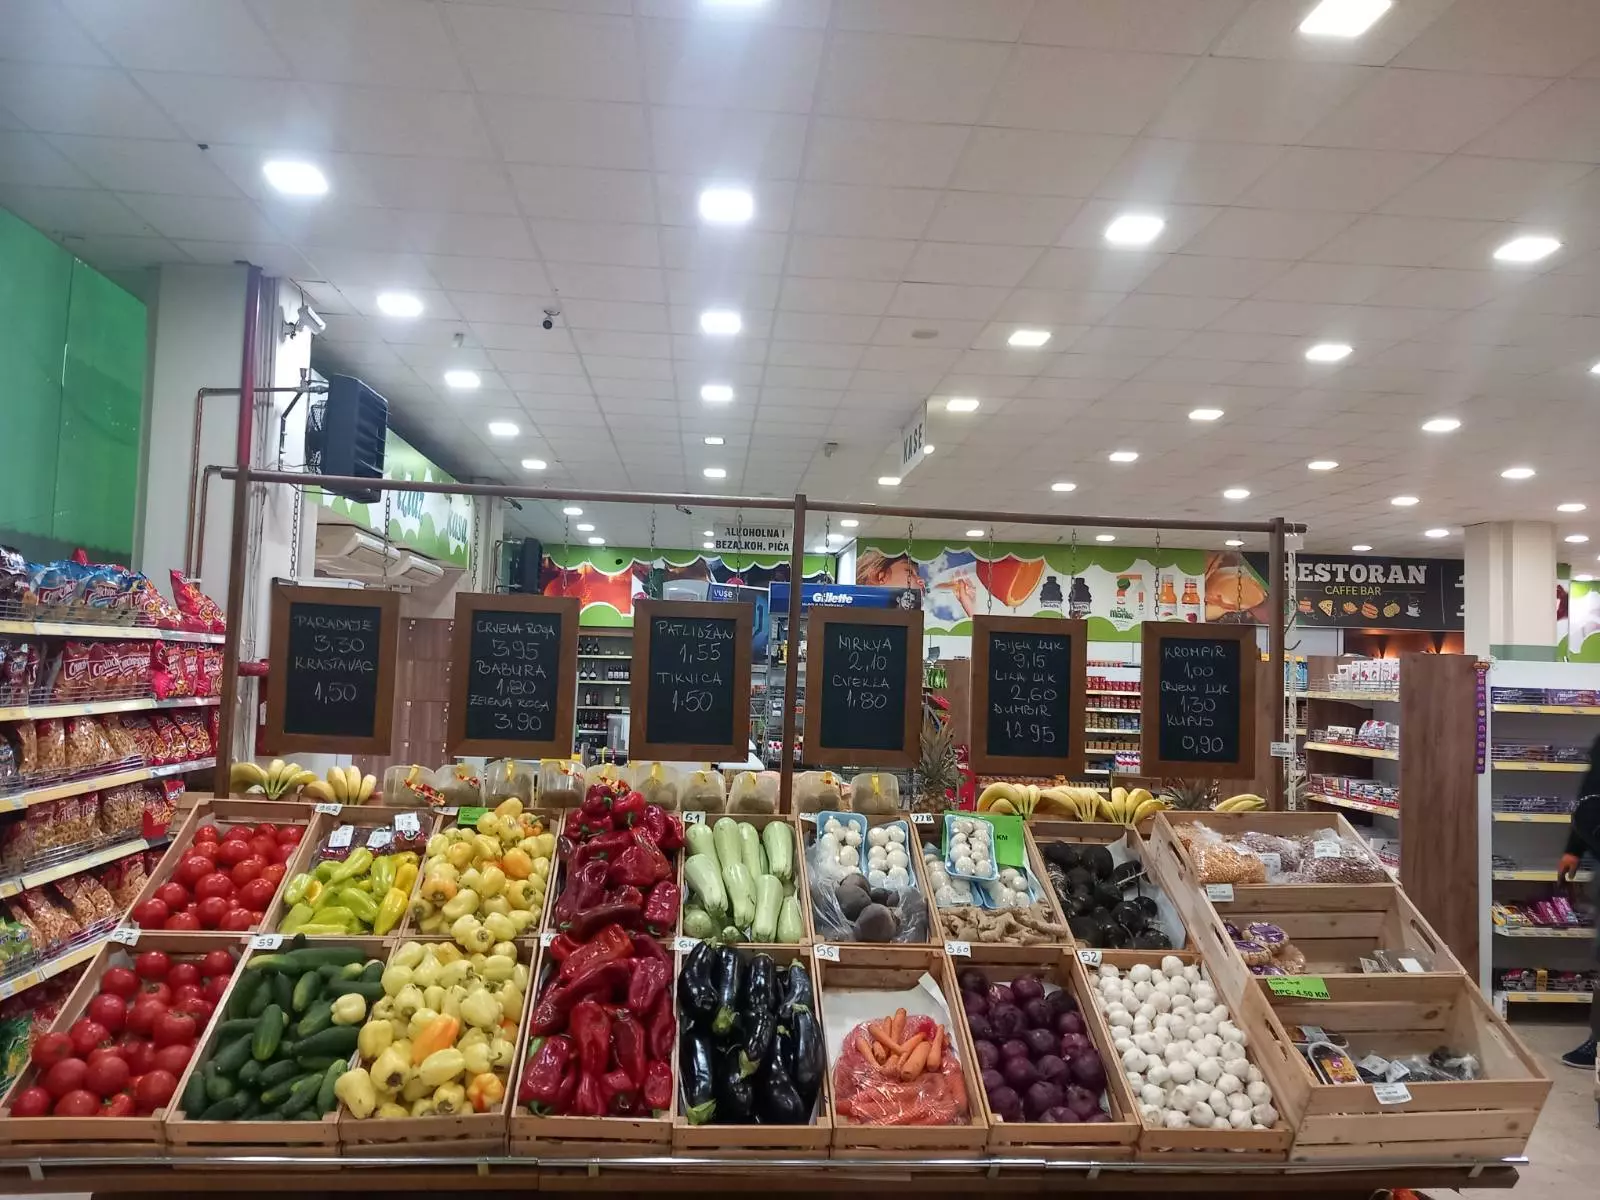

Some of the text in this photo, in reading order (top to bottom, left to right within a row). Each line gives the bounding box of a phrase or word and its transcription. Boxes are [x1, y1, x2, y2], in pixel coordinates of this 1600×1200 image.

[903, 423, 922, 464] KASE
[725, 527, 785, 538] ALKOHOLNA I
[715, 540, 766, 551] BEZALKOH.
[1325, 585, 1381, 595] CAFFE BAR
[812, 592, 853, 604] Gillette
[680, 643, 721, 664] 1,55
[475, 660, 547, 678] BABURA
[655, 672, 722, 686] TIKVICA
[314, 681, 357, 705] 1,50
[1010, 684, 1058, 704] 2,60
[1181, 735, 1225, 755] 0,90
[685, 812, 701, 823] 61
[113, 932, 132, 944] 57
[257, 938, 274, 947] 59
[815, 946, 834, 958] 56
[1081, 951, 1098, 963] 52
